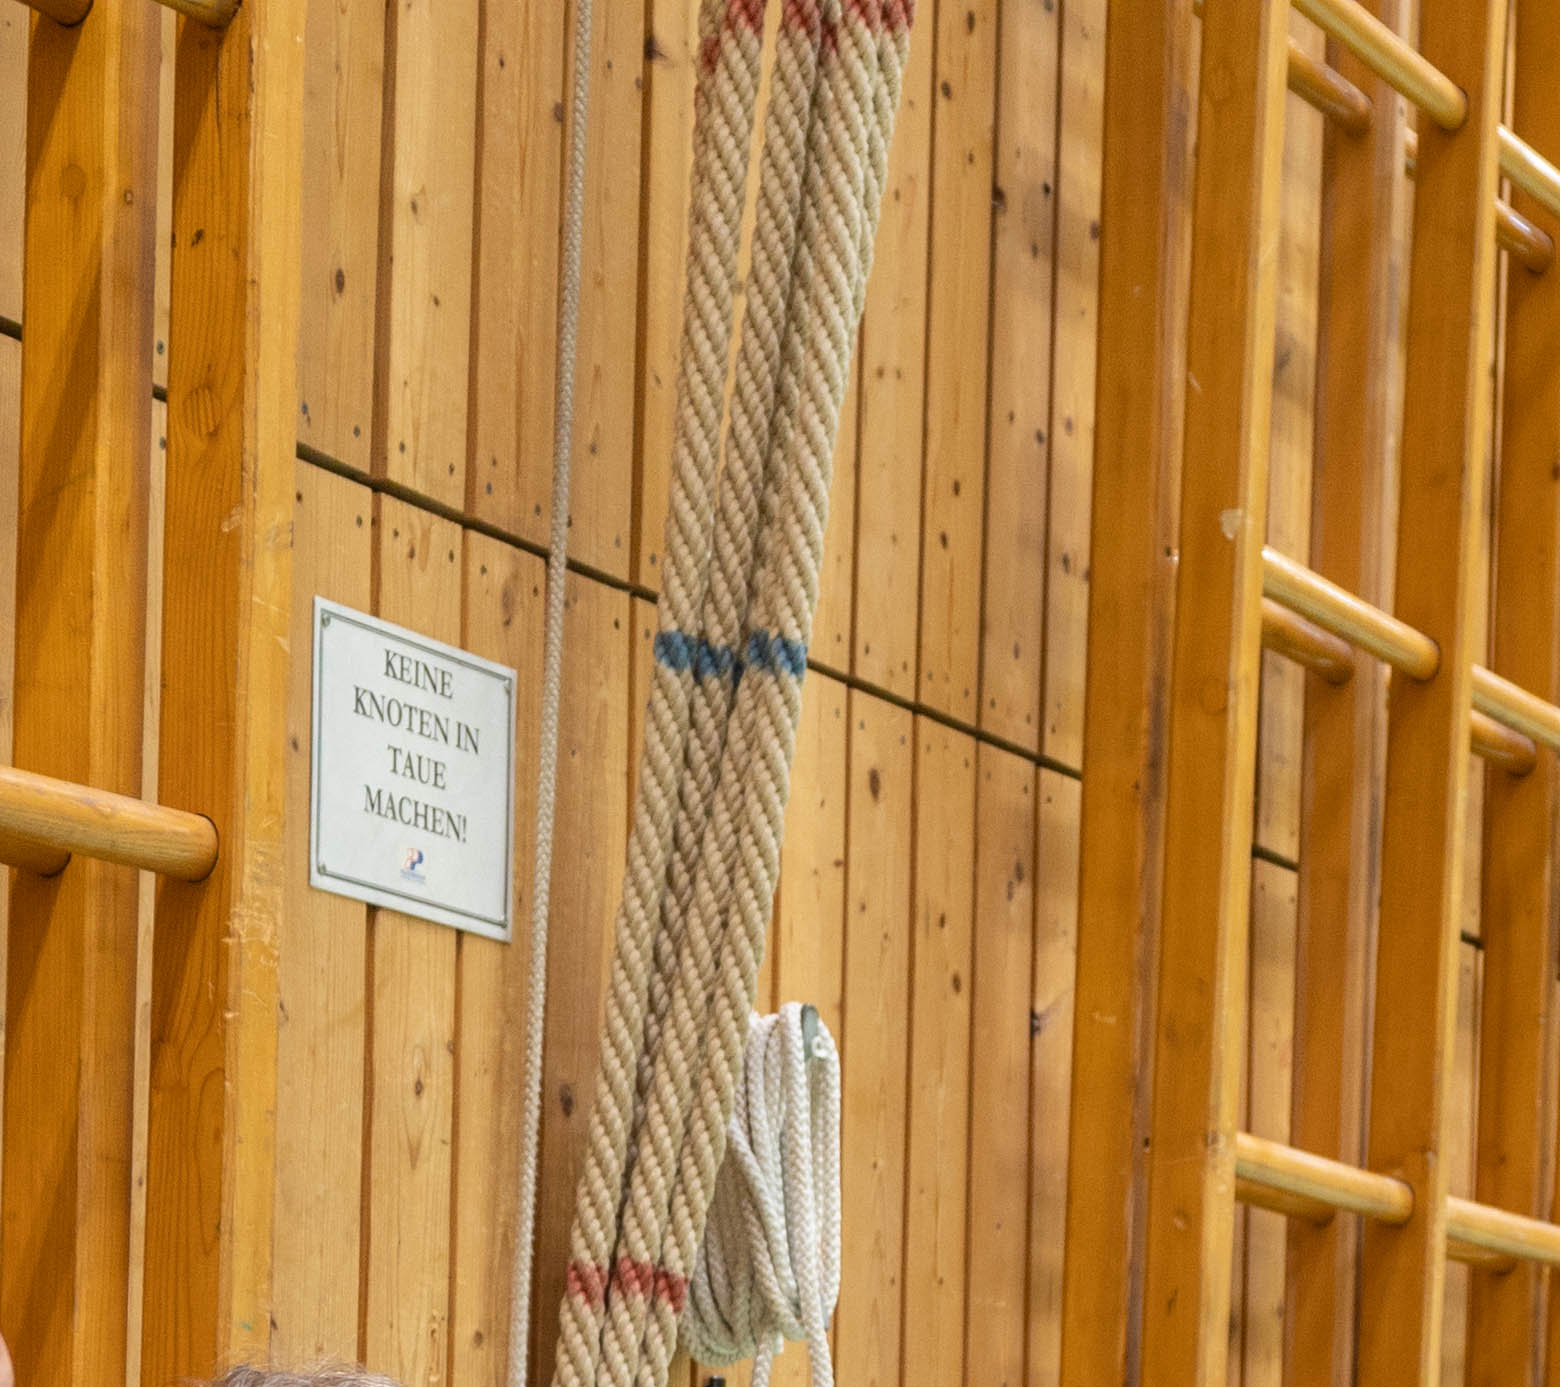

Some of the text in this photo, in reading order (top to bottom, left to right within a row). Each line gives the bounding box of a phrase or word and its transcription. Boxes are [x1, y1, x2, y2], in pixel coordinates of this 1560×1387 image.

[383, 648, 454, 700] KEINE
[352, 684, 480, 755] KNOTEN IN
[386, 744, 447, 790] TAUE
[364, 784, 468, 844] MACHEN!
